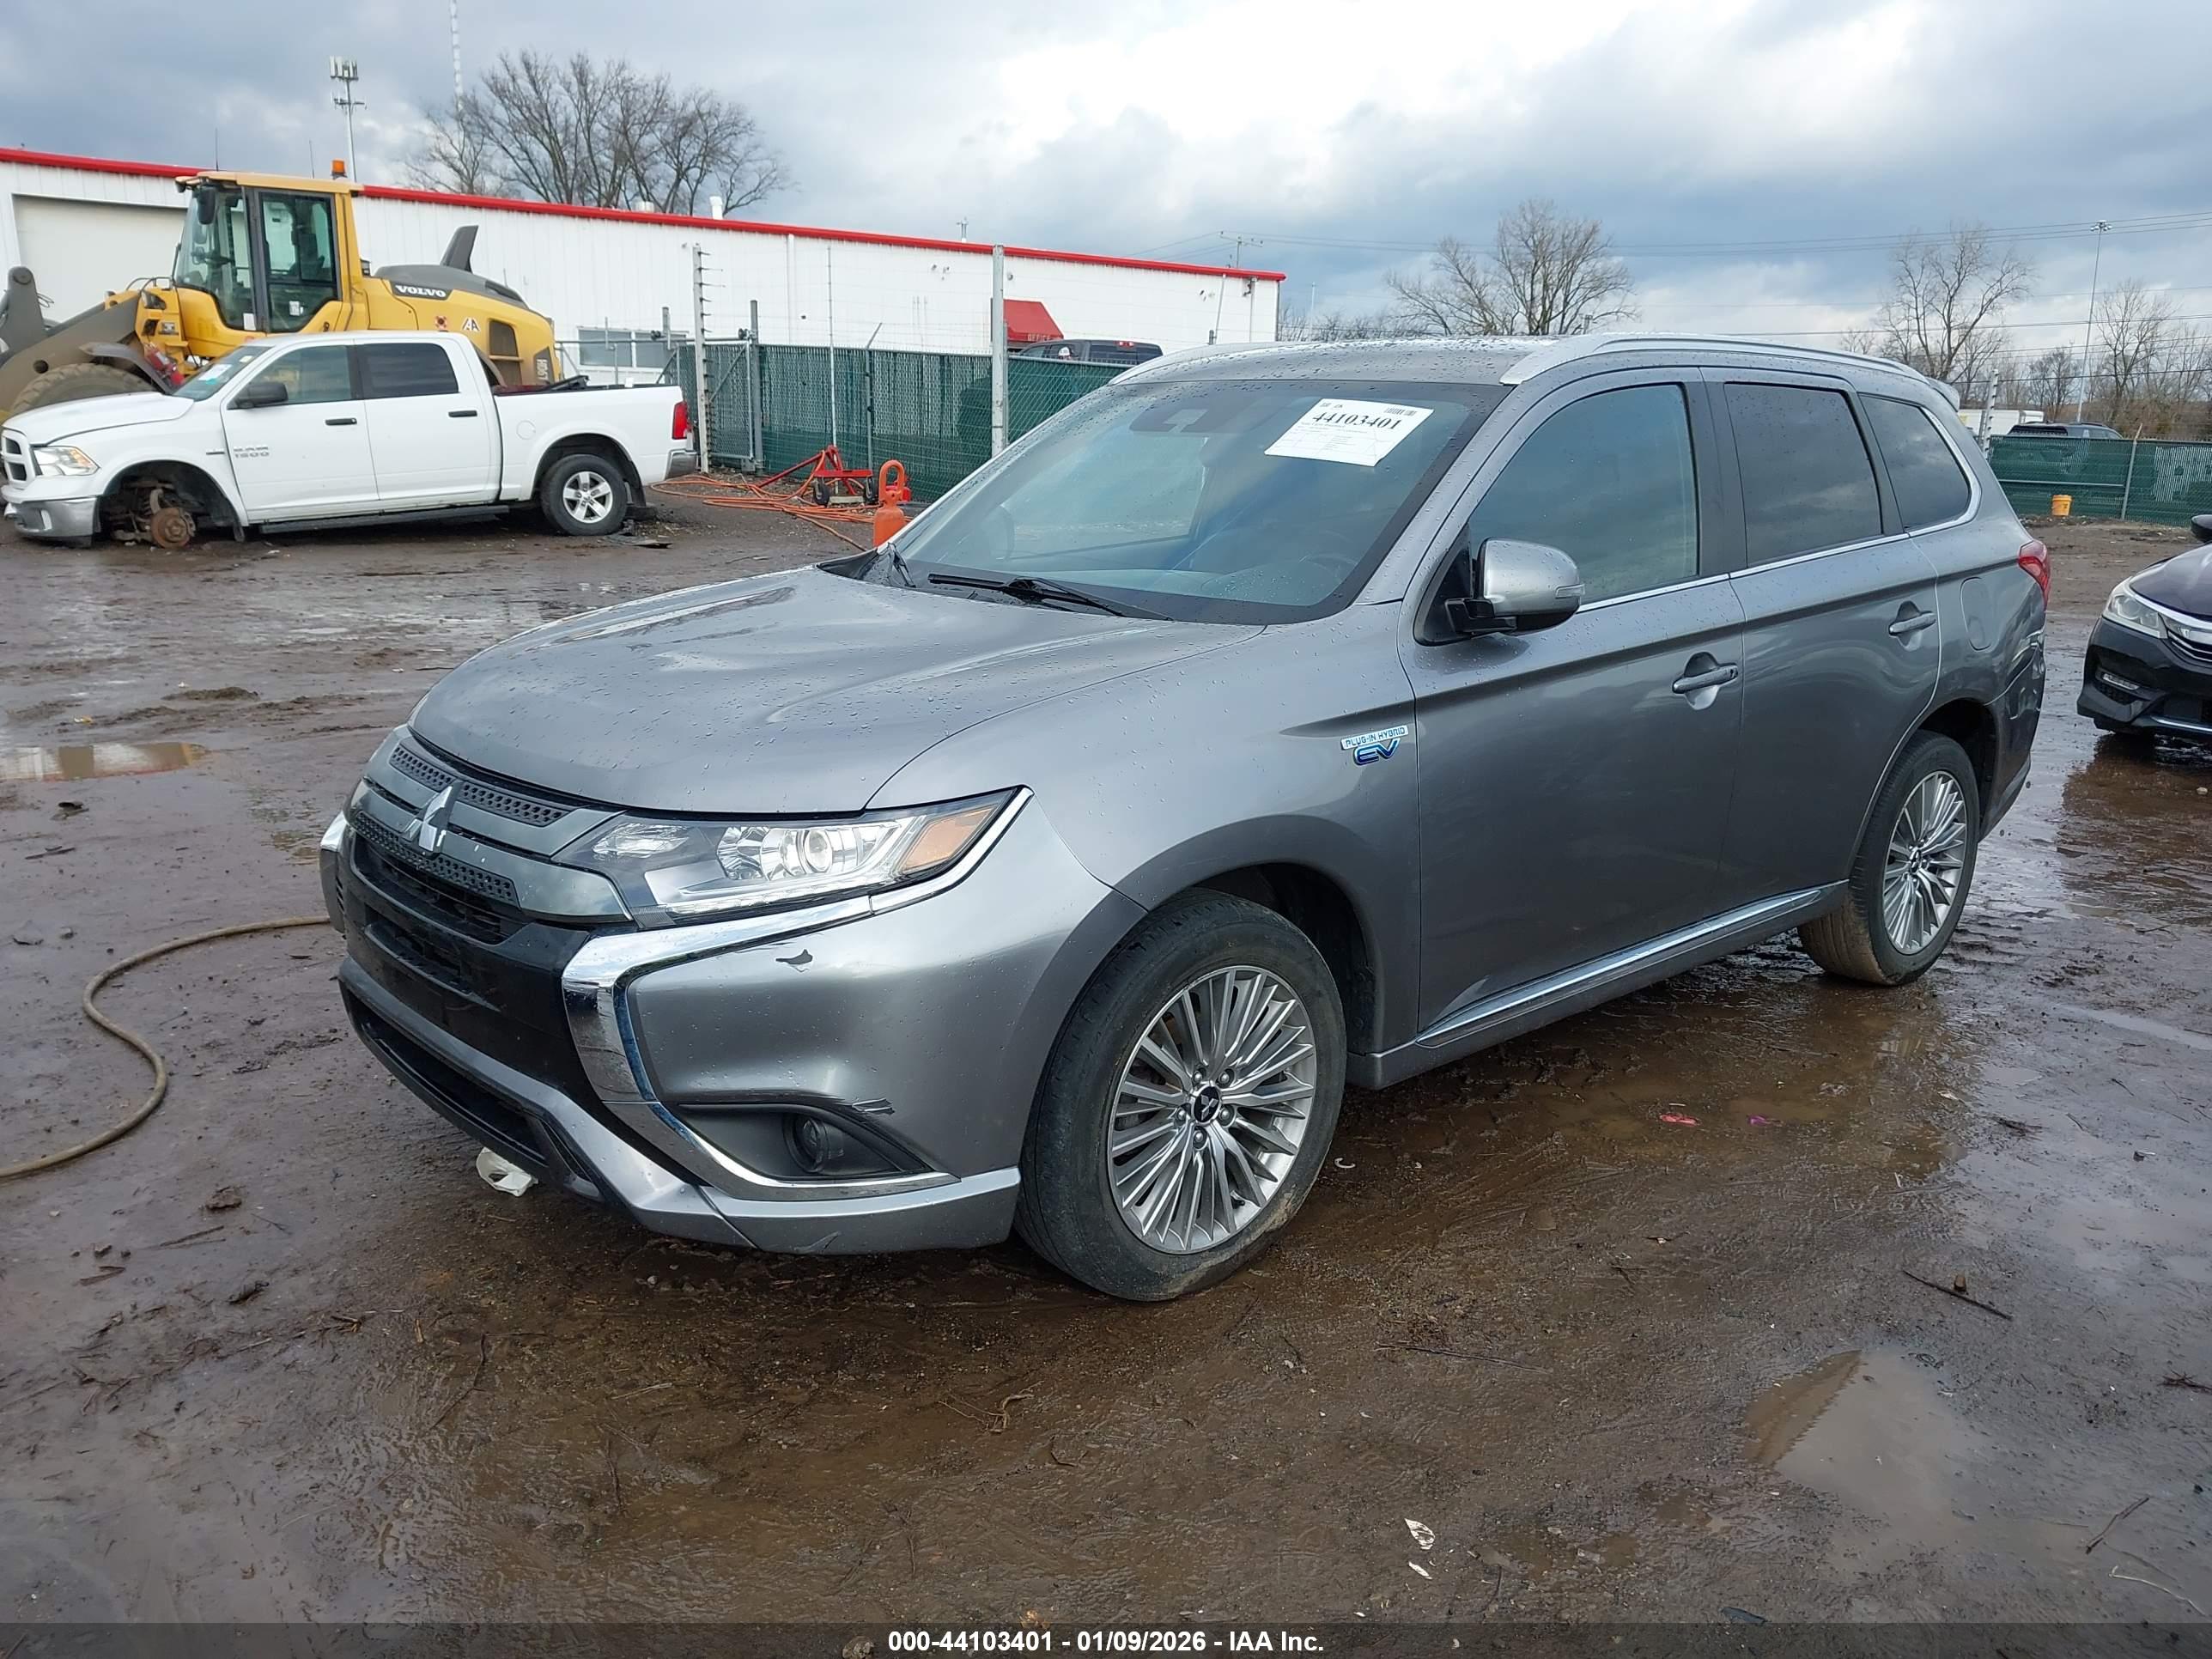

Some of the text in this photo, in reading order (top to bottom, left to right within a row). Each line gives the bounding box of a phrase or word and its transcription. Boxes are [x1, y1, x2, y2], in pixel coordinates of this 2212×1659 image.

[395, 284, 447, 298] VOLVO
[1312, 412, 1402, 430] 44103401
[1345, 726, 1406, 748] PLUG-IN HYBRID
[1354, 738, 1401, 766] EV
